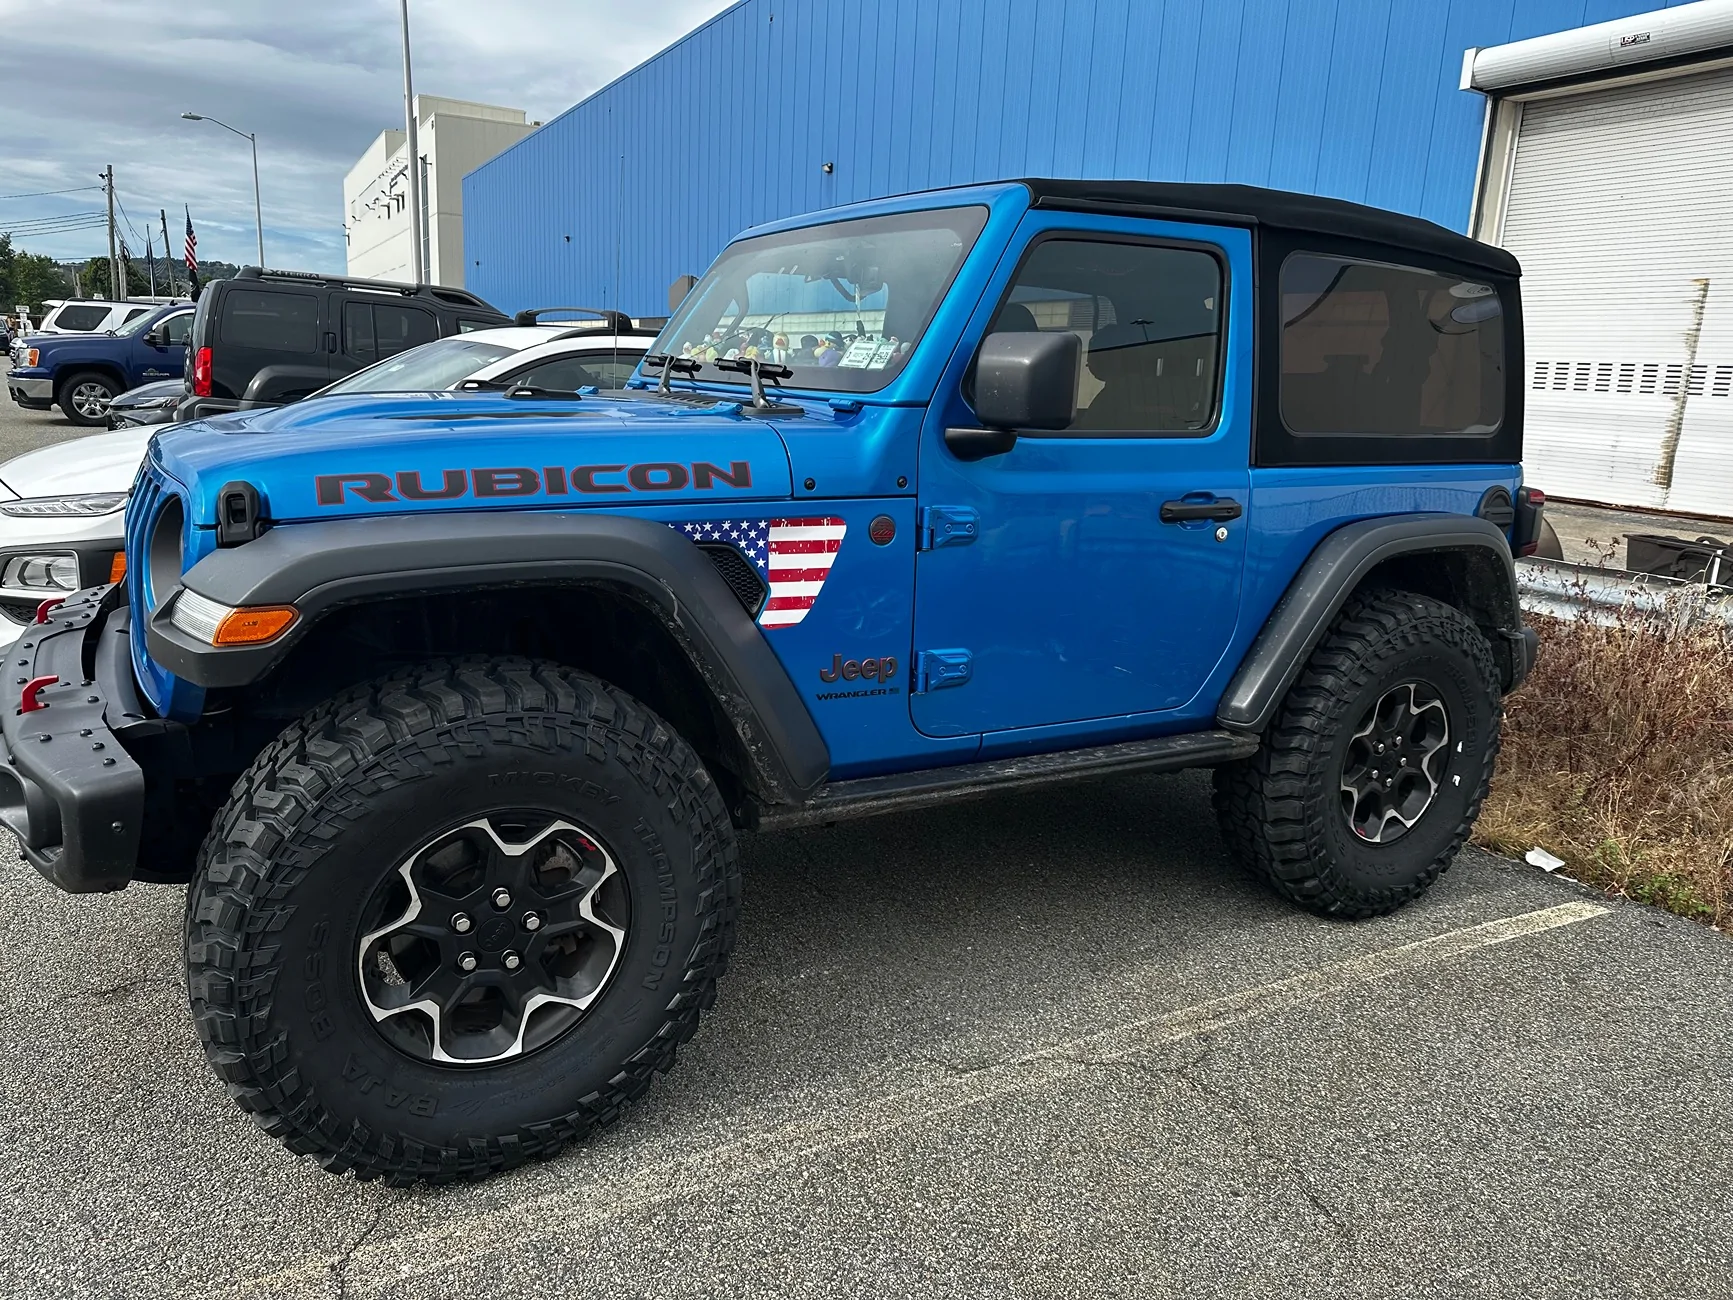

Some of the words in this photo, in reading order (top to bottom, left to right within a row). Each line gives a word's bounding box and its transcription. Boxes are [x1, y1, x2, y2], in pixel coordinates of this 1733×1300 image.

[315, 460, 752, 506] RUBICON
[820, 653, 898, 684] Jeep
[816, 688, 887, 701] WRANGLER
[486, 770, 622, 807] MICKEY
[632, 815, 679, 992] THOMPSON
[483, 921, 508, 948] Jeep
[303, 918, 337, 1042] BOSS
[341, 1053, 441, 1119] BAJA
